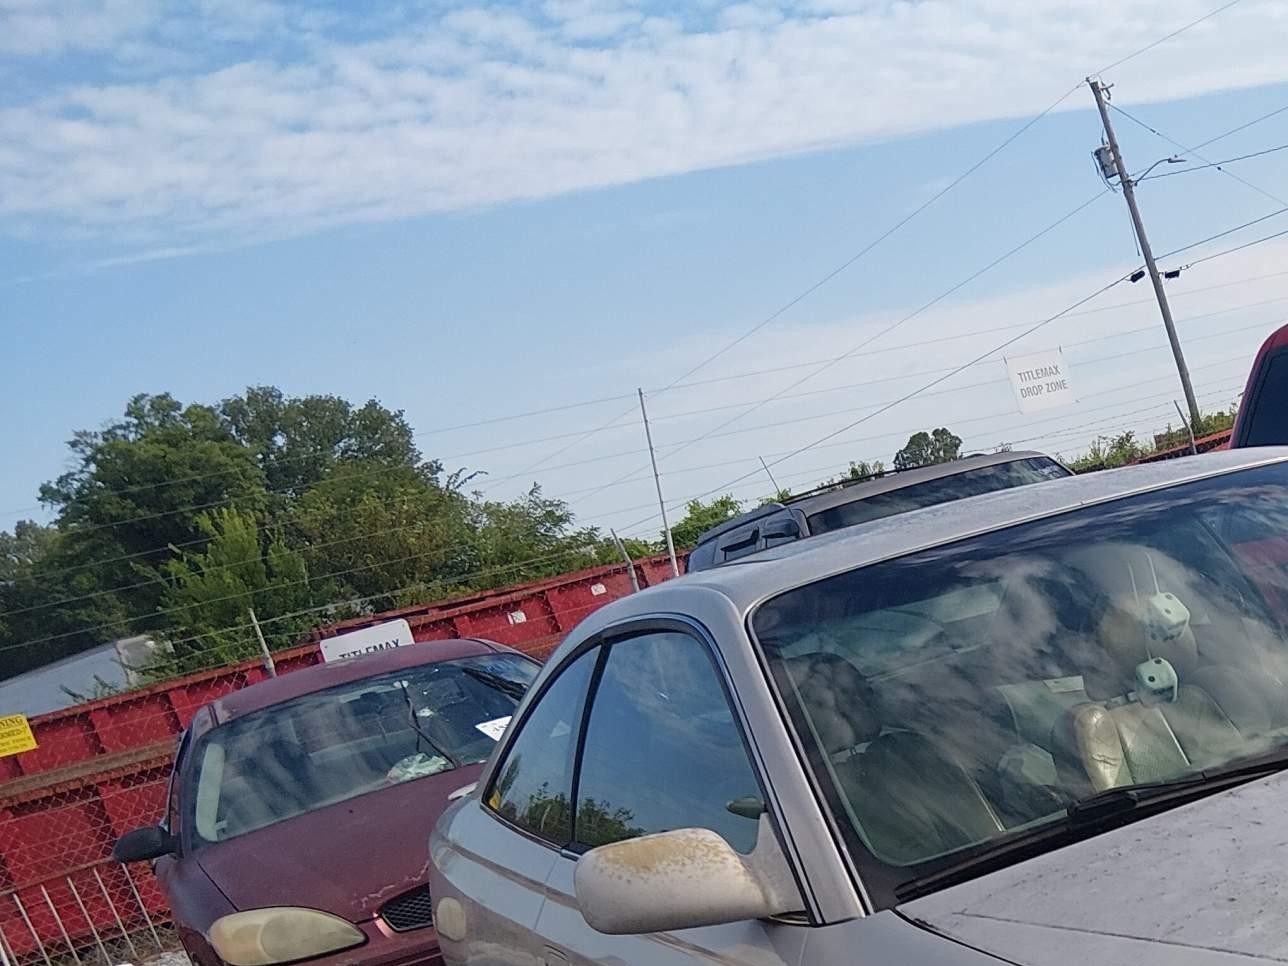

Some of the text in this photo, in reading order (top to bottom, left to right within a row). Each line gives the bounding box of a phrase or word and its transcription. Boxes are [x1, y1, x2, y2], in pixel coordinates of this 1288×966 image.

[1017, 365, 1060, 383] TITLEMAX
[1020, 379, 1068, 398] DROP ZONE
